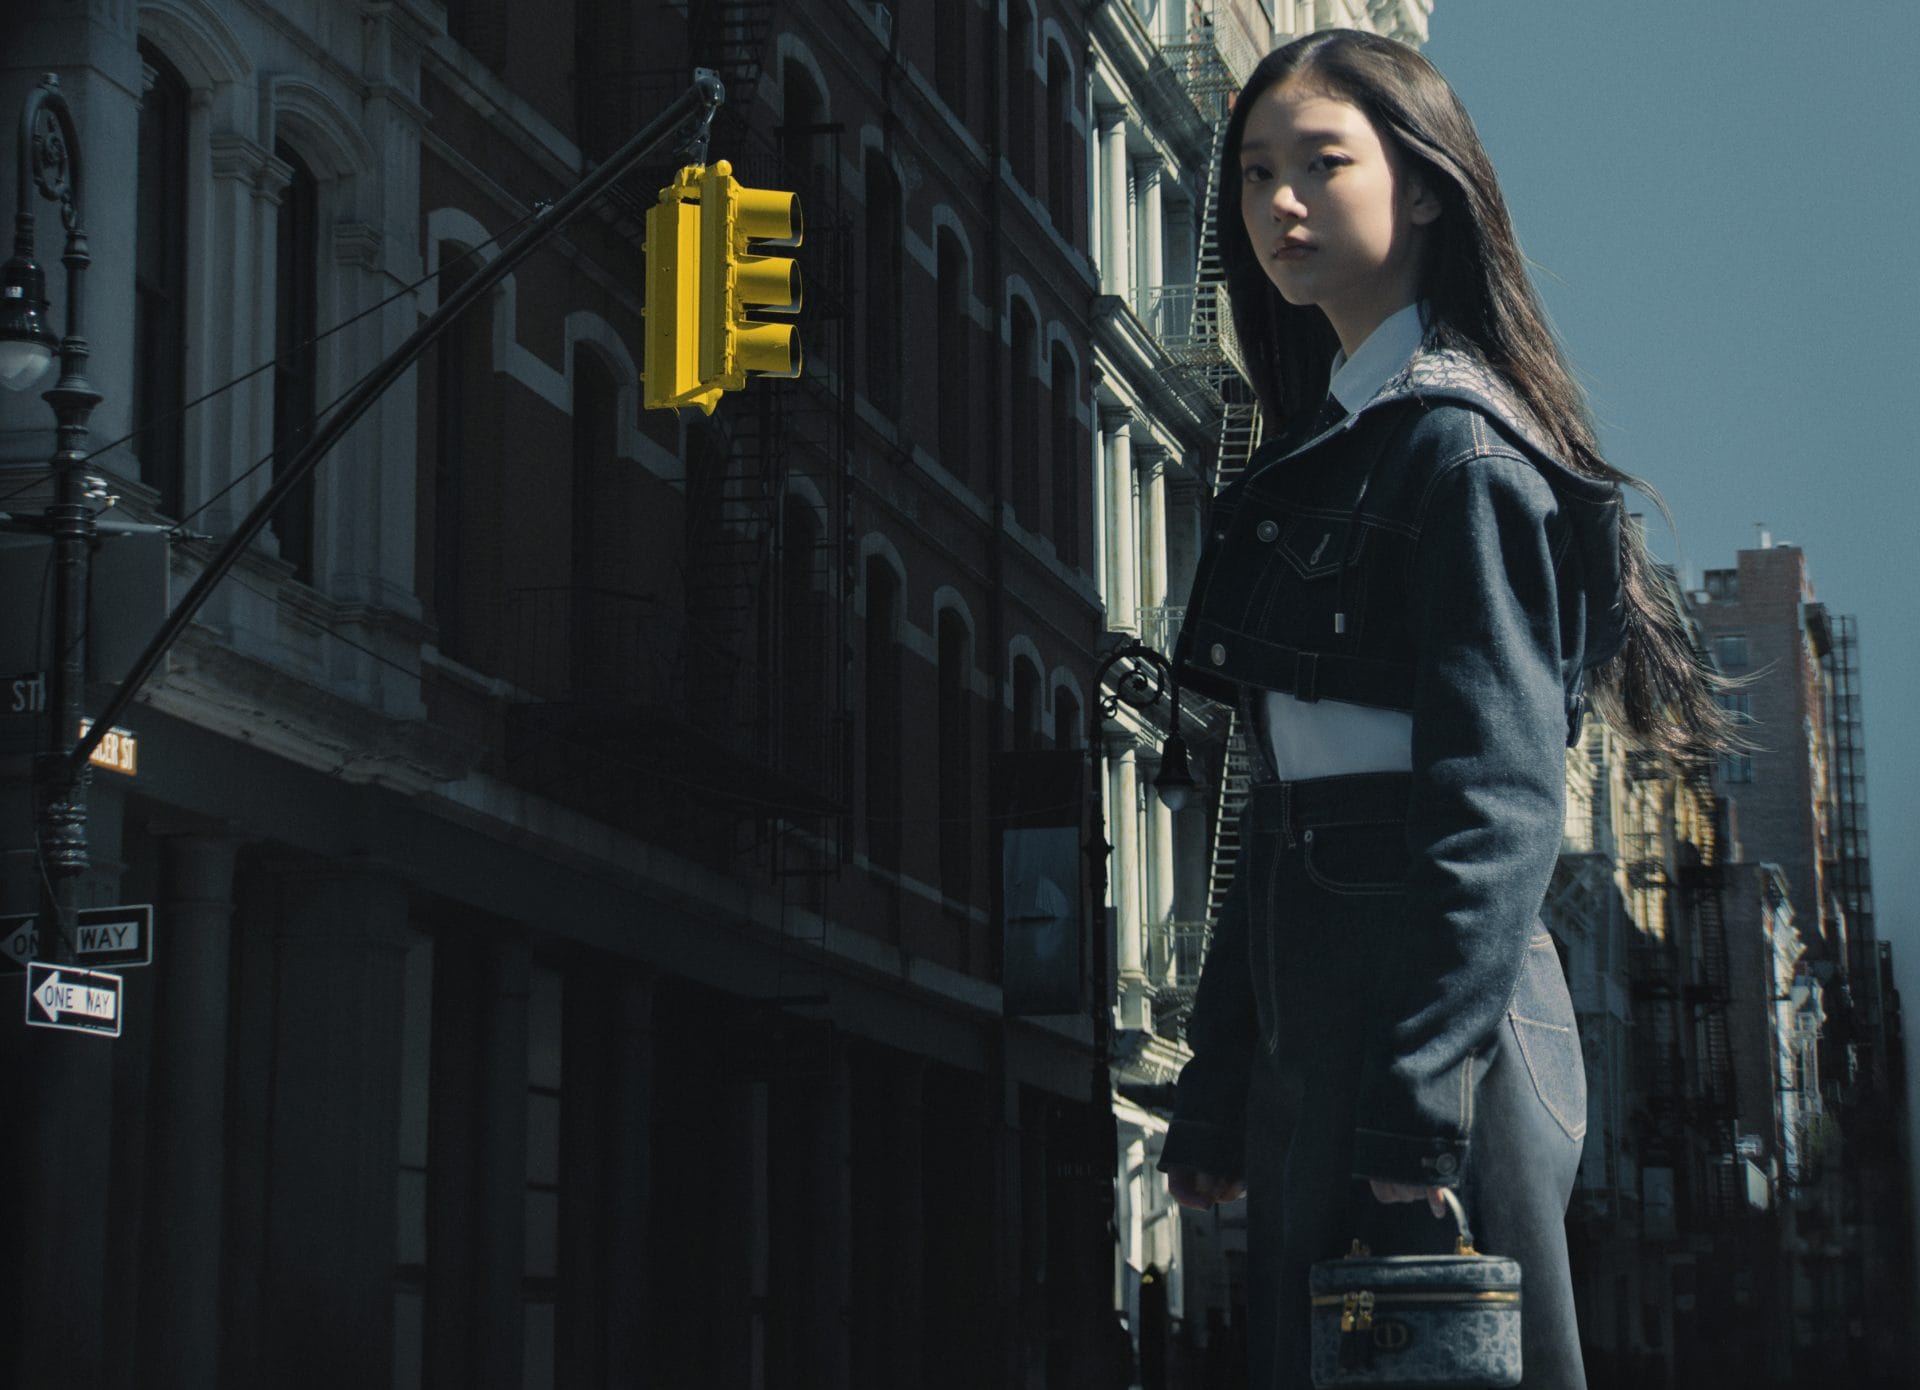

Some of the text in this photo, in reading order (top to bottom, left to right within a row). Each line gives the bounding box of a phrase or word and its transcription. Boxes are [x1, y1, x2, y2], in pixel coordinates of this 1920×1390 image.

[80, 926, 127, 949] WAY
[45, 985, 110, 1014] ONE WAY
